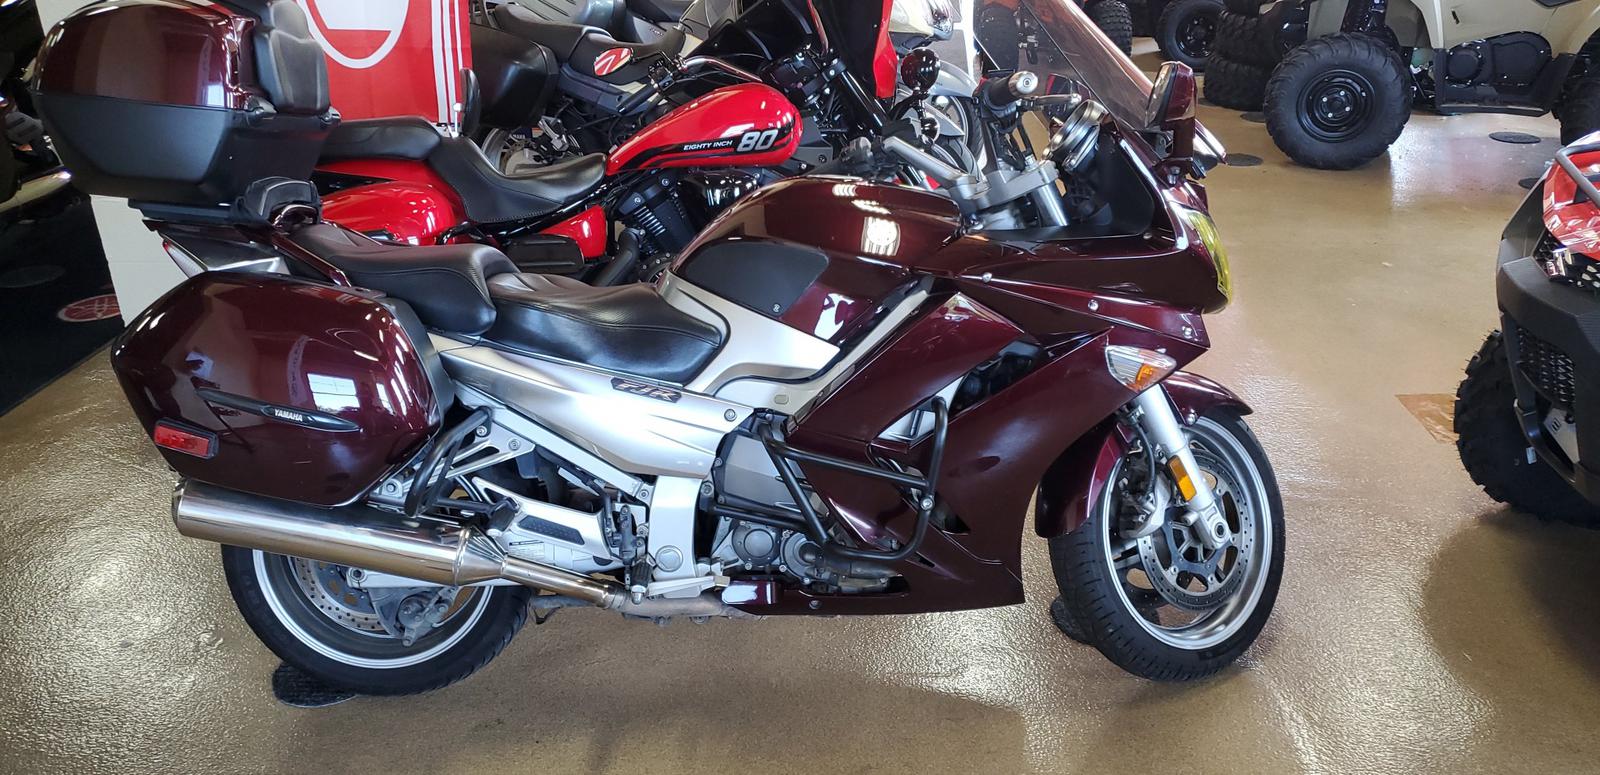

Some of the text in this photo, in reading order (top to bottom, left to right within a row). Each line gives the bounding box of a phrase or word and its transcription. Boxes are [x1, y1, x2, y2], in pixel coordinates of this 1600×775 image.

[683, 129, 778, 152] EIGHTY INCH 80
[615, 379, 678, 401] FJR
[274, 408, 303, 422] YAMAHA
